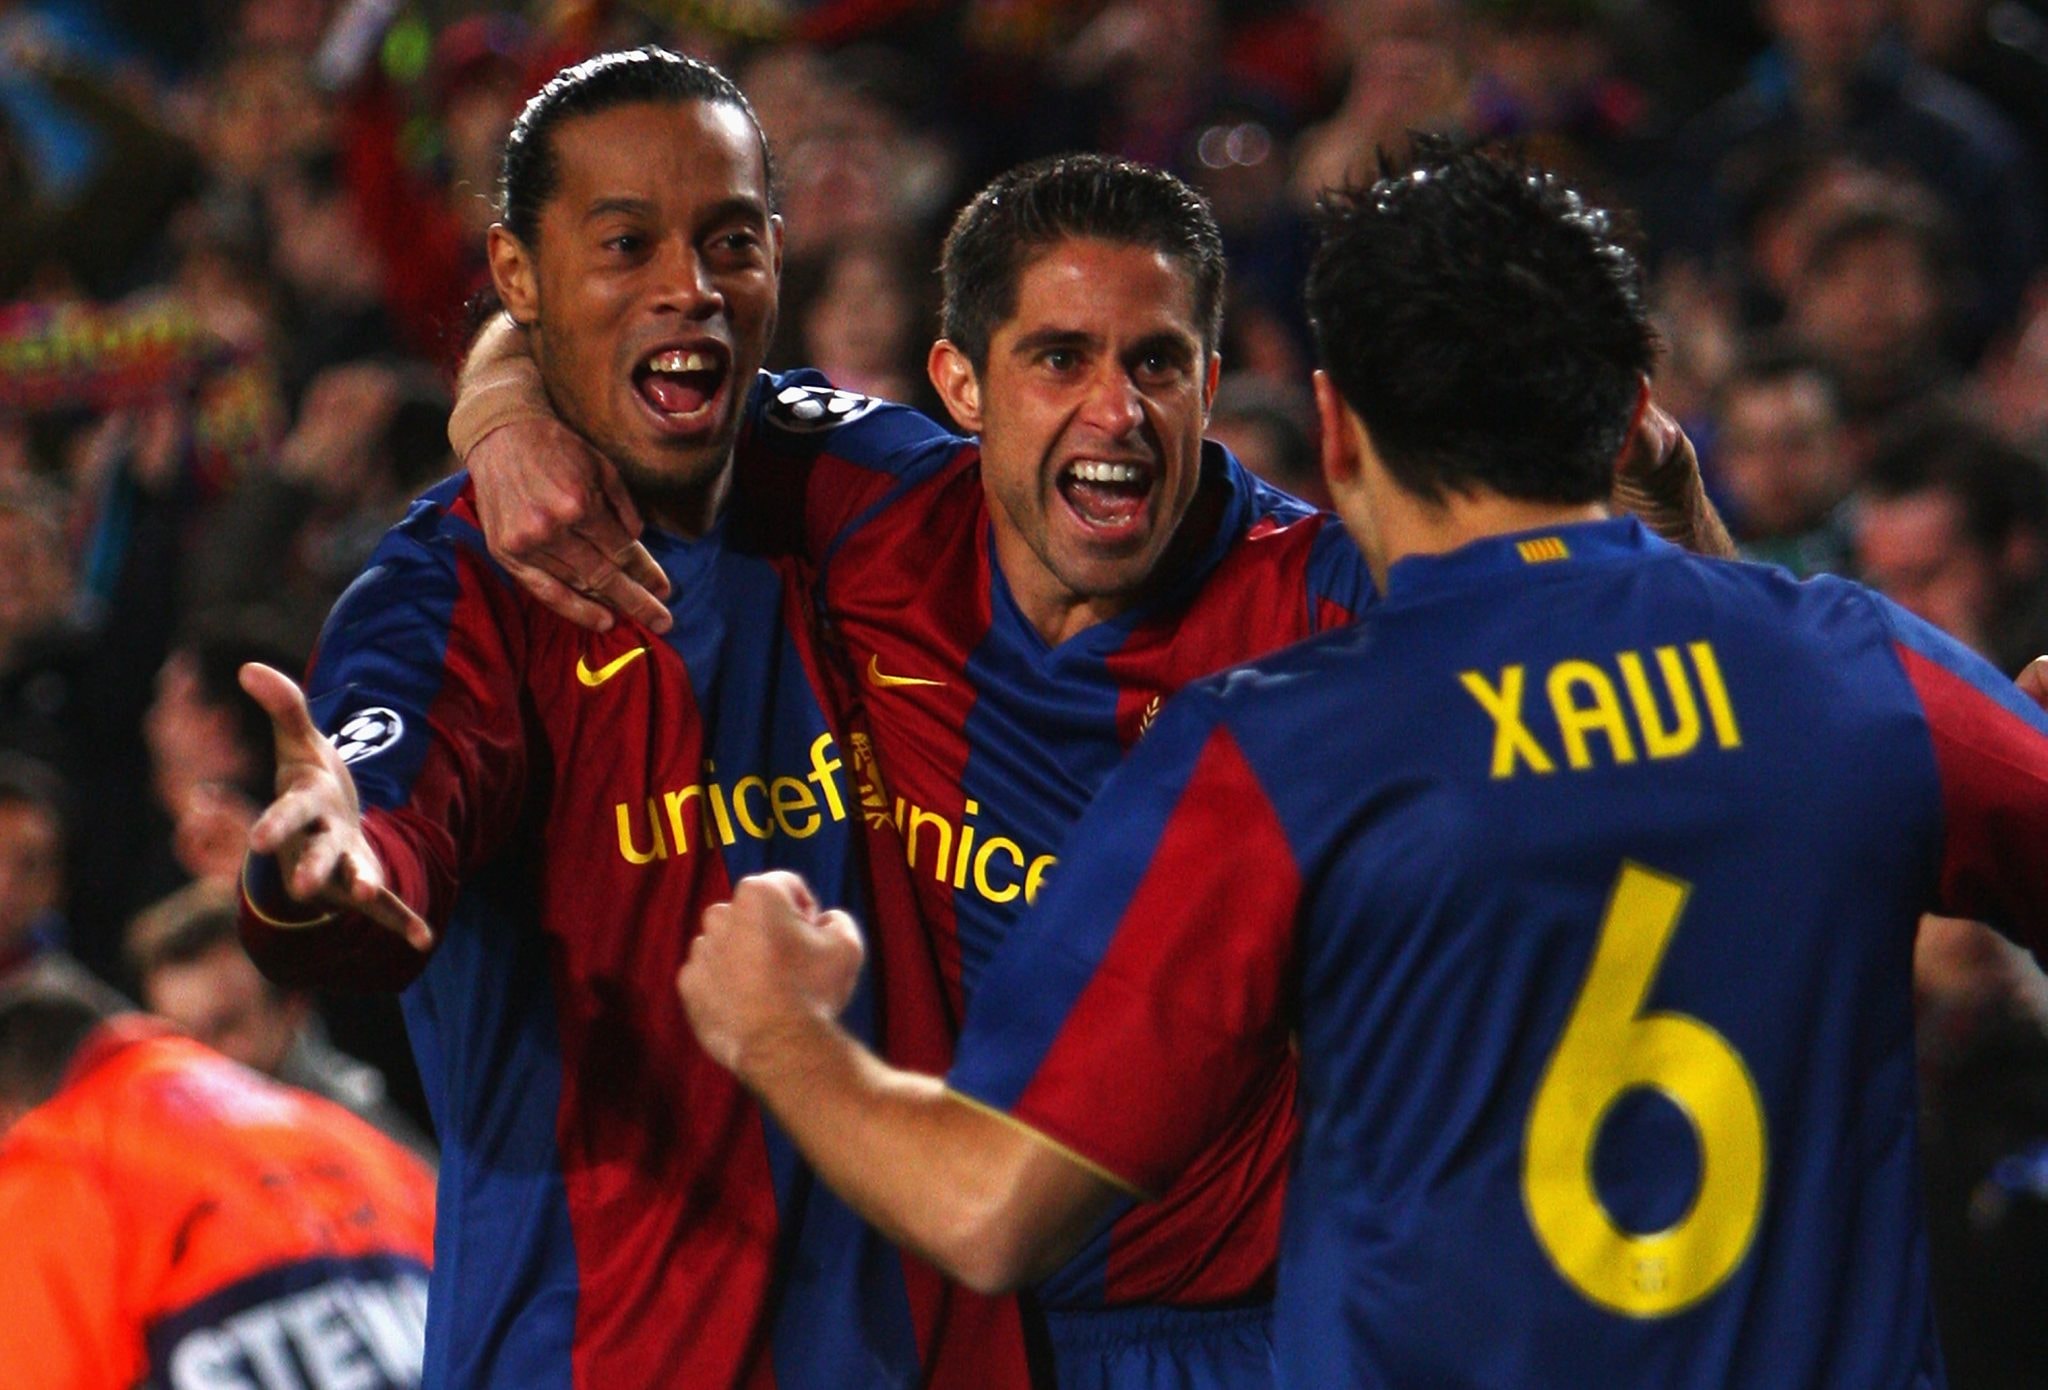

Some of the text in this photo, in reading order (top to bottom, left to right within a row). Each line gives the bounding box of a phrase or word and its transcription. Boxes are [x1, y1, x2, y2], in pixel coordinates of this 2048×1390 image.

[1458, 640, 1741, 780] XAVI
[616, 732, 846, 865] unicef
[1522, 860, 1768, 1318] 6
